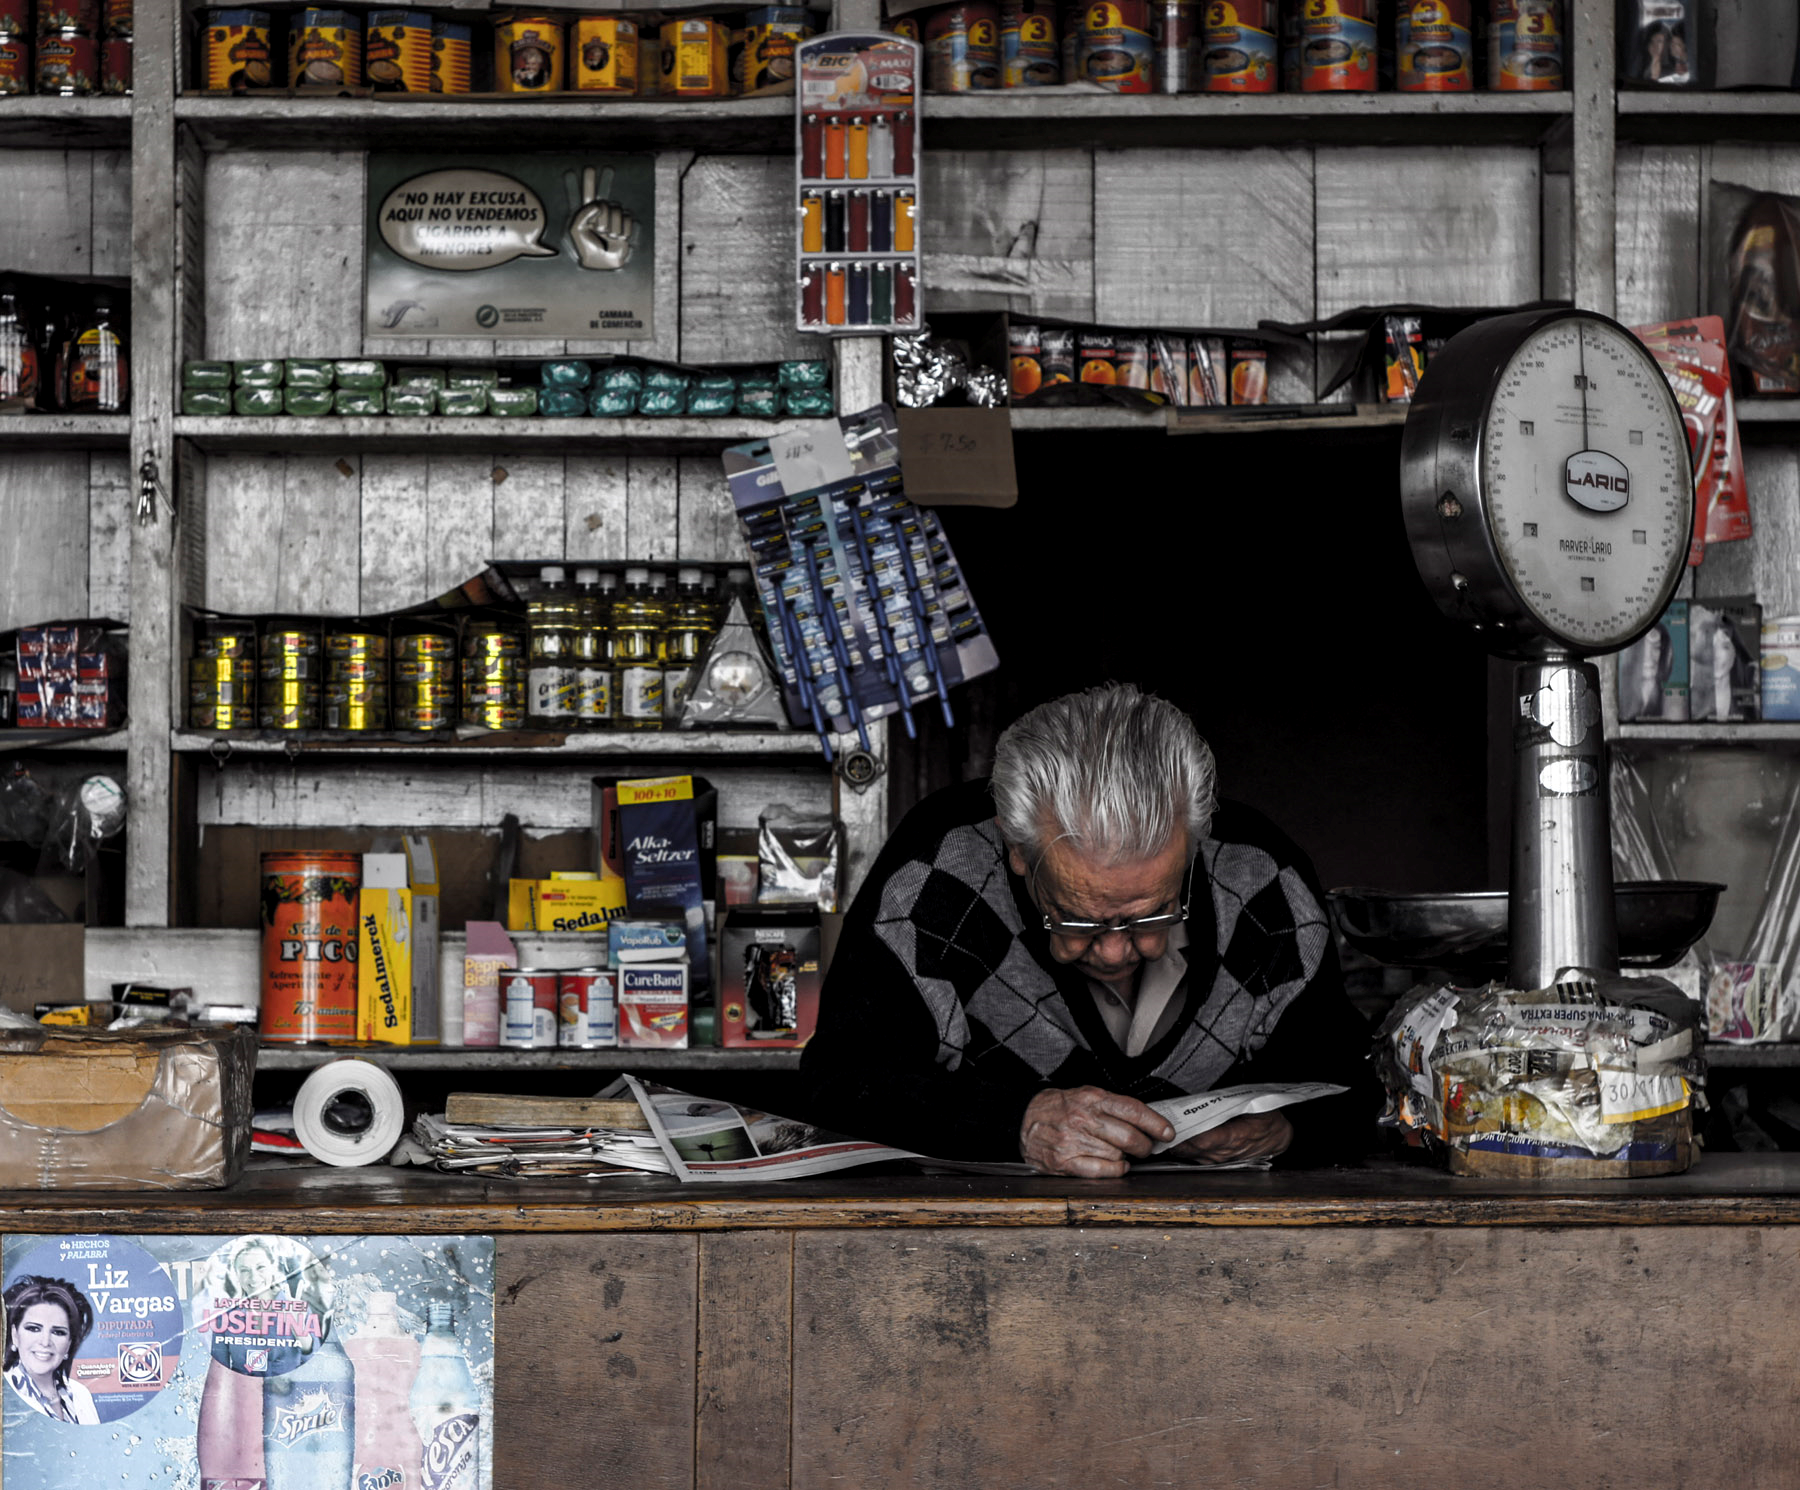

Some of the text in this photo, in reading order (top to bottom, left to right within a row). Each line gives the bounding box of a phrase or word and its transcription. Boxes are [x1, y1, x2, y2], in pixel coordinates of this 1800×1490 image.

[1210, 2, 1225, 26] 3
[1310, 0, 1326, 16] 3
[1093, 4, 1109, 27] 3
[1527, 12, 1544, 33] 3
[978, 21, 991, 43] 3
[1030, 17, 1046, 39] 3
[818, 56, 851, 66] BIC
[880, 59, 911, 68] MAXI
[433, 192, 465, 205] HAY
[469, 192, 526, 205] EXCUSA
[386, 208, 538, 222] AQUI NO VENDEMOS
[416, 226, 506, 238] CIGARROS A
[599, 310, 633, 319] CAMARA
[590, 320, 643, 328] DE COMERCIO
[1590, 381, 1596, 390] kg
[1664, 372, 1703, 397] RMA
[1568, 468, 1628, 493] LARIO
[1530, 526, 1536, 536] 2
[1560, 539, 1612, 554] MARVER-LARIO
[634, 790, 653, 801] 100
[664, 788, 676, 798] 10
[626, 836, 672, 852] Alka-
[634, 849, 696, 864] Seltzer
[553, 906, 627, 932] Sedalm
[288, 921, 320, 935] Sal
[325, 924, 341, 935] de
[620, 935, 662, 946] VapoRub
[280, 940, 358, 962] PICO
[269, 971, 330, 980] Refresante
[366, 914, 398, 1028] Sedalmerck
[625, 972, 682, 986] CureBand
[1520, 1009, 1552, 1020] EXTRA
[1554, 1009, 1586, 1021] SUPER
[1610, 1083, 1628, 1102] 30
[1183, 1102, 1209, 1116] mdp
[60, 1240, 110, 1250] de HECHOS
[60, 1250, 108, 1262] y PALABRA
[88, 1264, 128, 1289] Liz
[91, 1292, 175, 1318] Vargas
[96, 1320, 154, 1331] DIPUTADA
[198, 1308, 322, 1338] JOSEFINA
[215, 1336, 303, 1348] PRESIDENTA
[278, 1407, 336, 1440] Sprite
